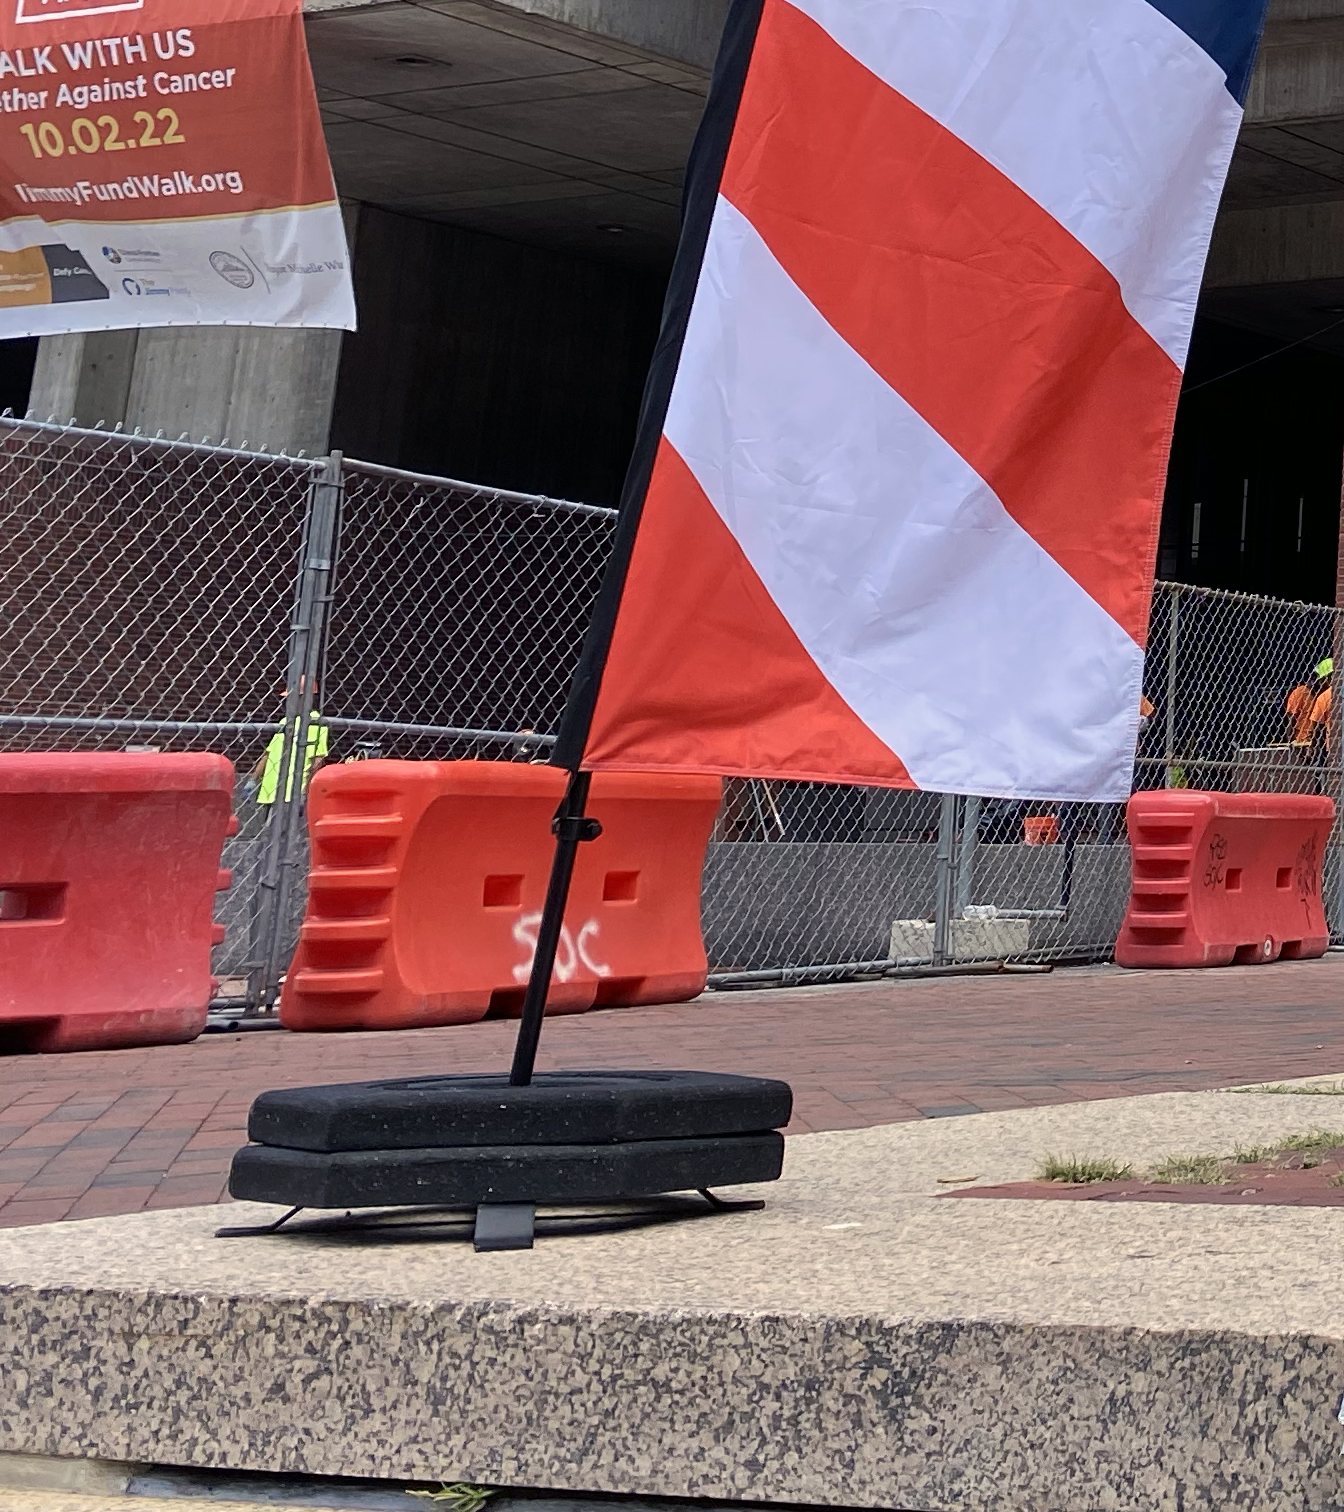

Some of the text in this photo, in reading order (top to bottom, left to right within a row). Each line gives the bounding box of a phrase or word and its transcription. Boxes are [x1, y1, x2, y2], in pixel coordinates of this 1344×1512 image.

[61, 34, 147, 71] WITH
[153, 28, 195, 60] US
[0, 67, 236, 113] ther Against Cancer
[20, 107, 186, 159] 10.02.22
